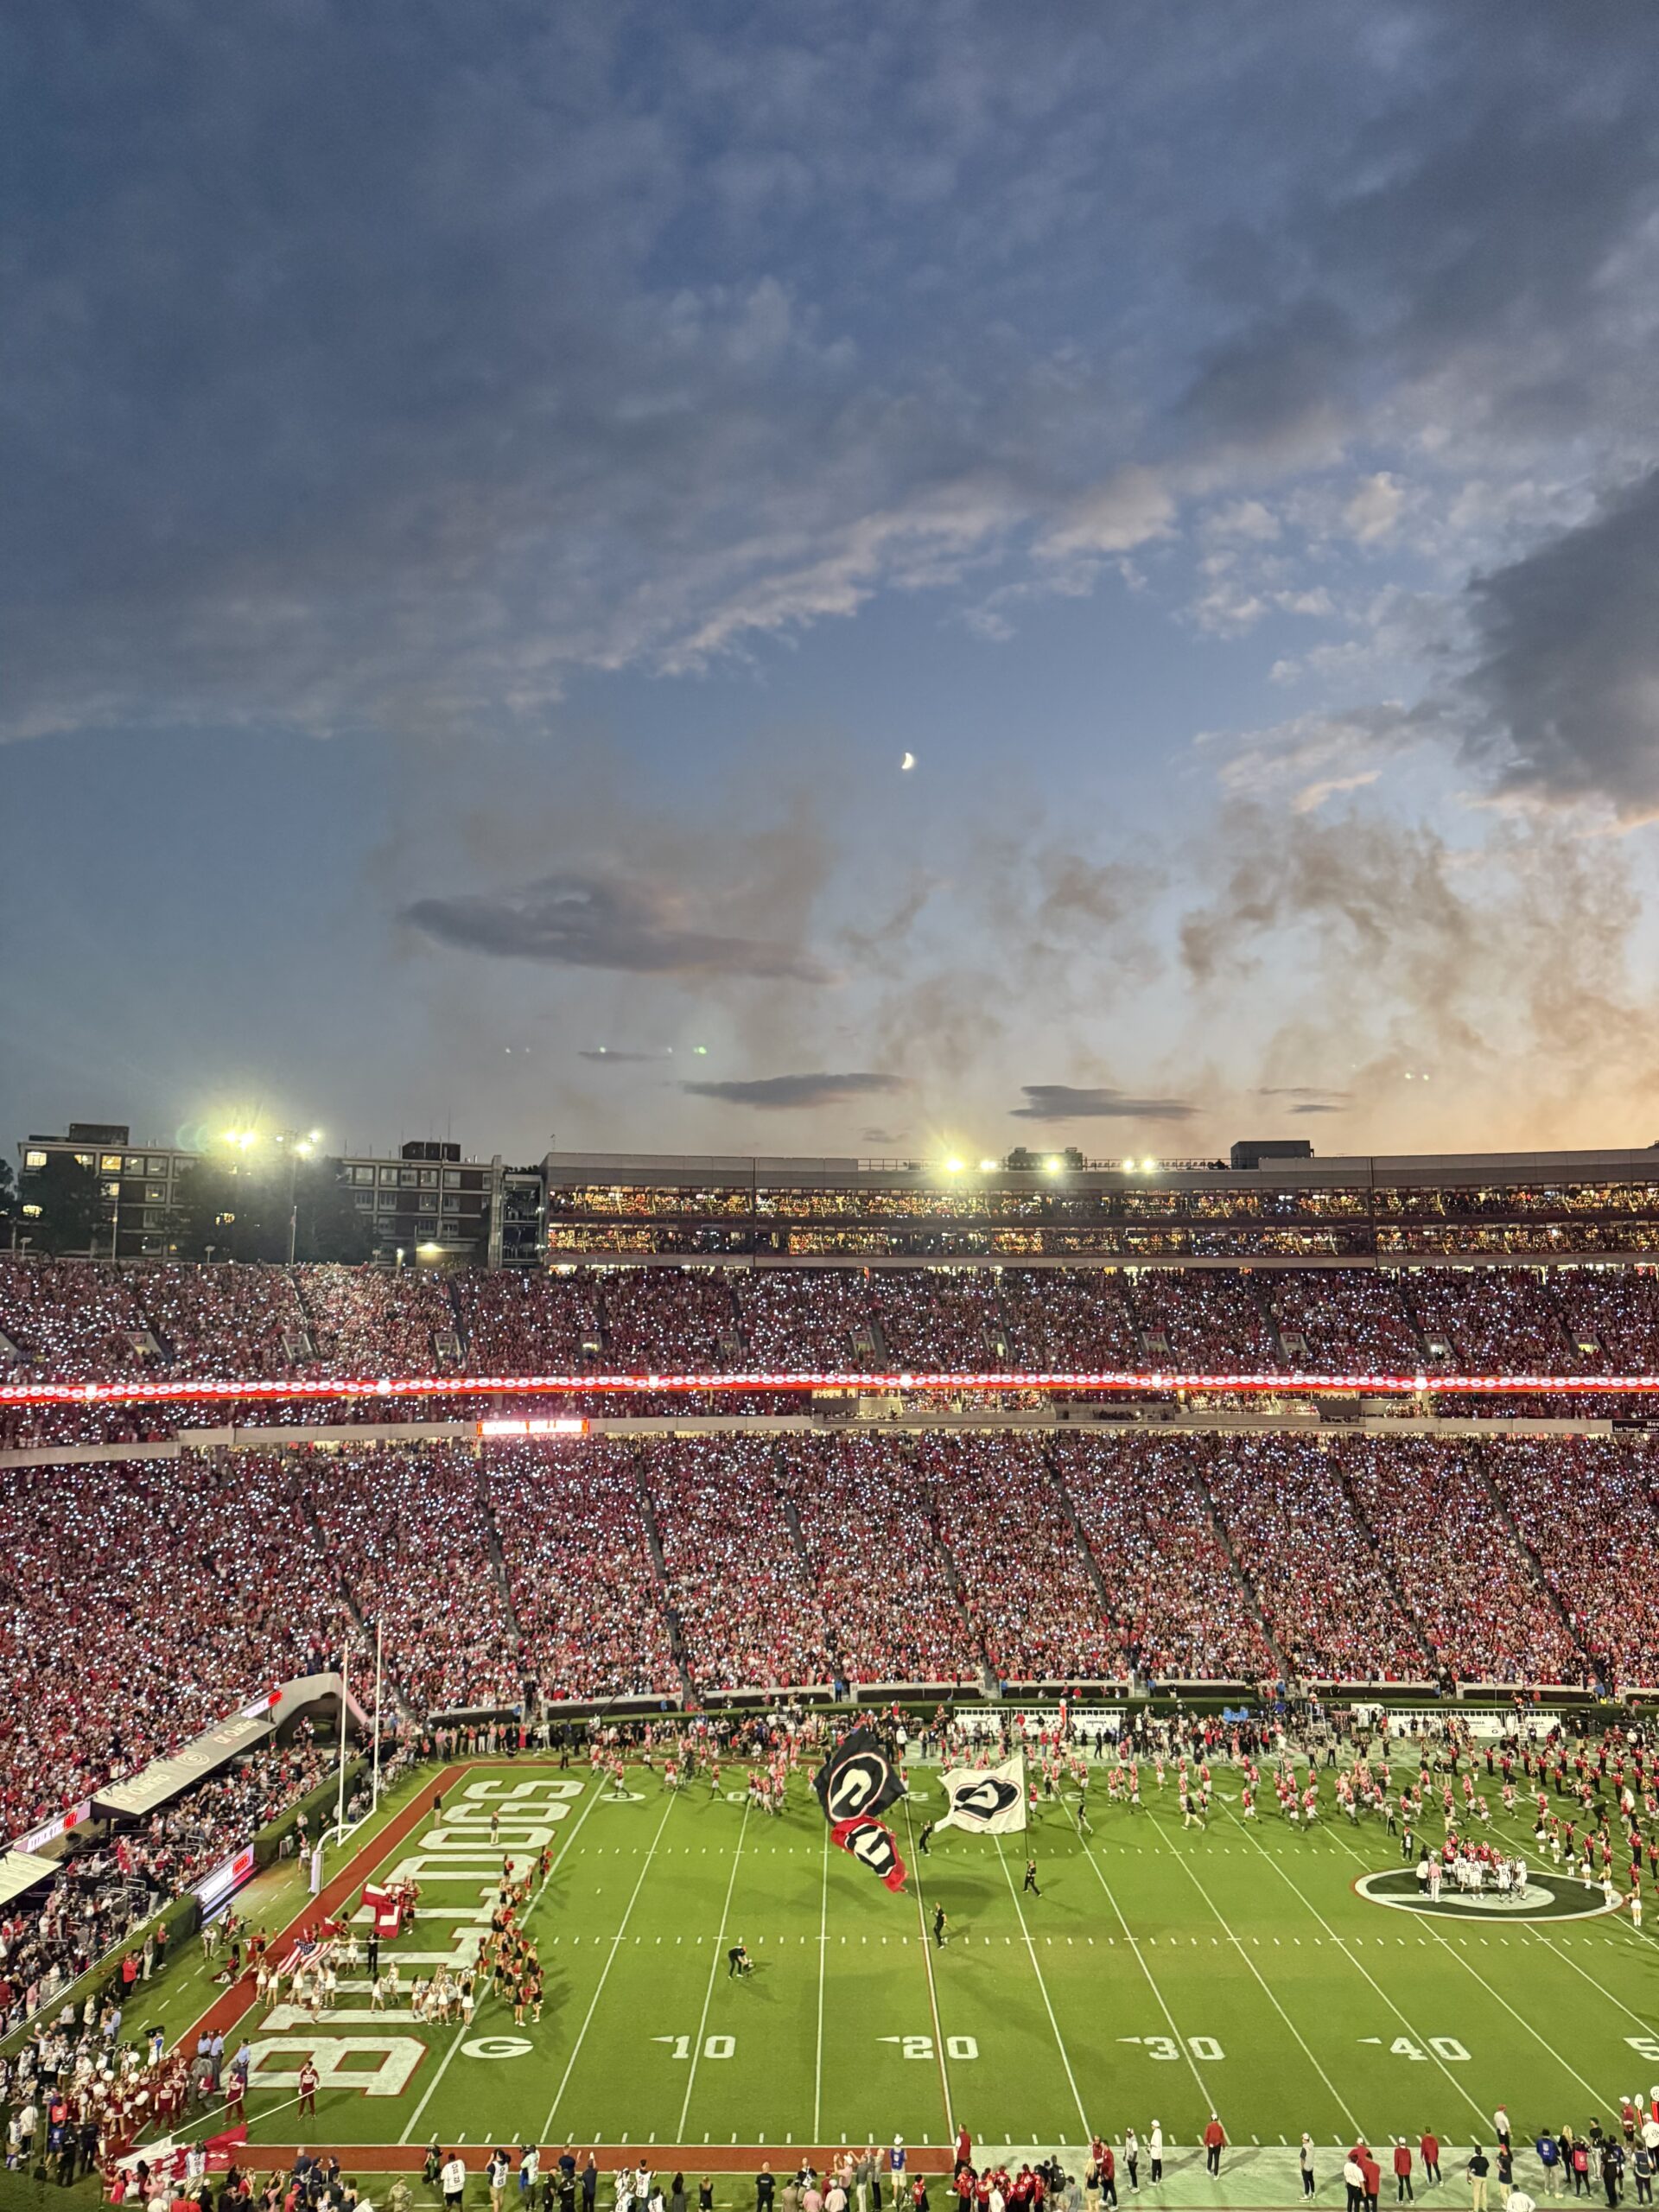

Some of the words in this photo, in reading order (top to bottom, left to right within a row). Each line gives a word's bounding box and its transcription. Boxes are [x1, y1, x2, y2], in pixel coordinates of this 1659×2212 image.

[461, 2036, 534, 2059] G
[671, 2035, 737, 2060] 10
[902, 2035, 979, 2060] 20
[1147, 2036, 1225, 2061] 30
[1389, 2037, 1472, 2062] 40
